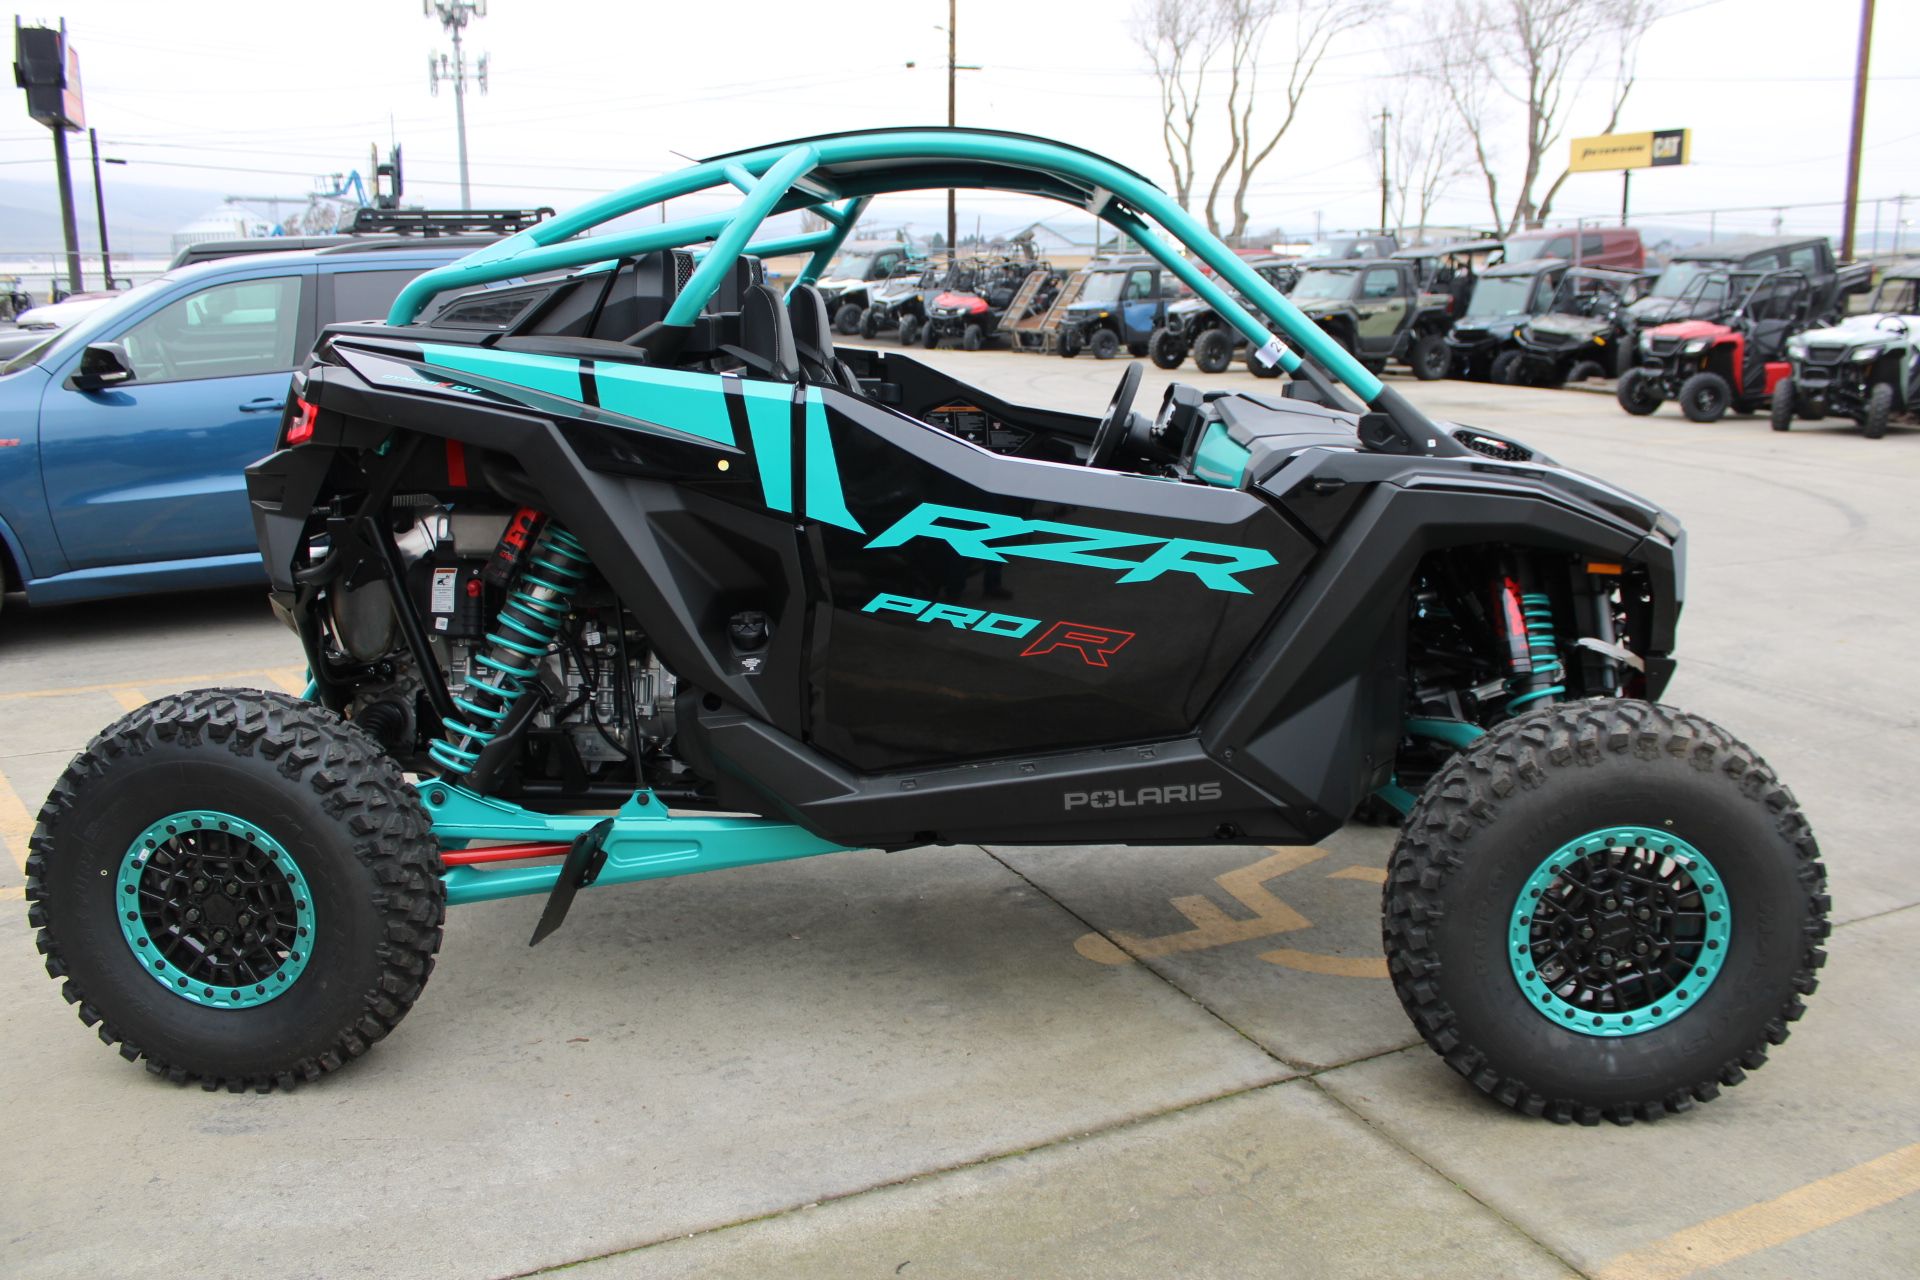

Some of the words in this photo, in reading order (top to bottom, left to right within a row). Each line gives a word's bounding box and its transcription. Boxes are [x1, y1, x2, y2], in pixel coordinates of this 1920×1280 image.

[1653, 136, 1681, 158] CAT
[863, 502, 1279, 594] RZR
[861, 592, 1042, 639] PRO
[1020, 621, 1136, 668] R
[1064, 782, 1222, 810] POLARIS
